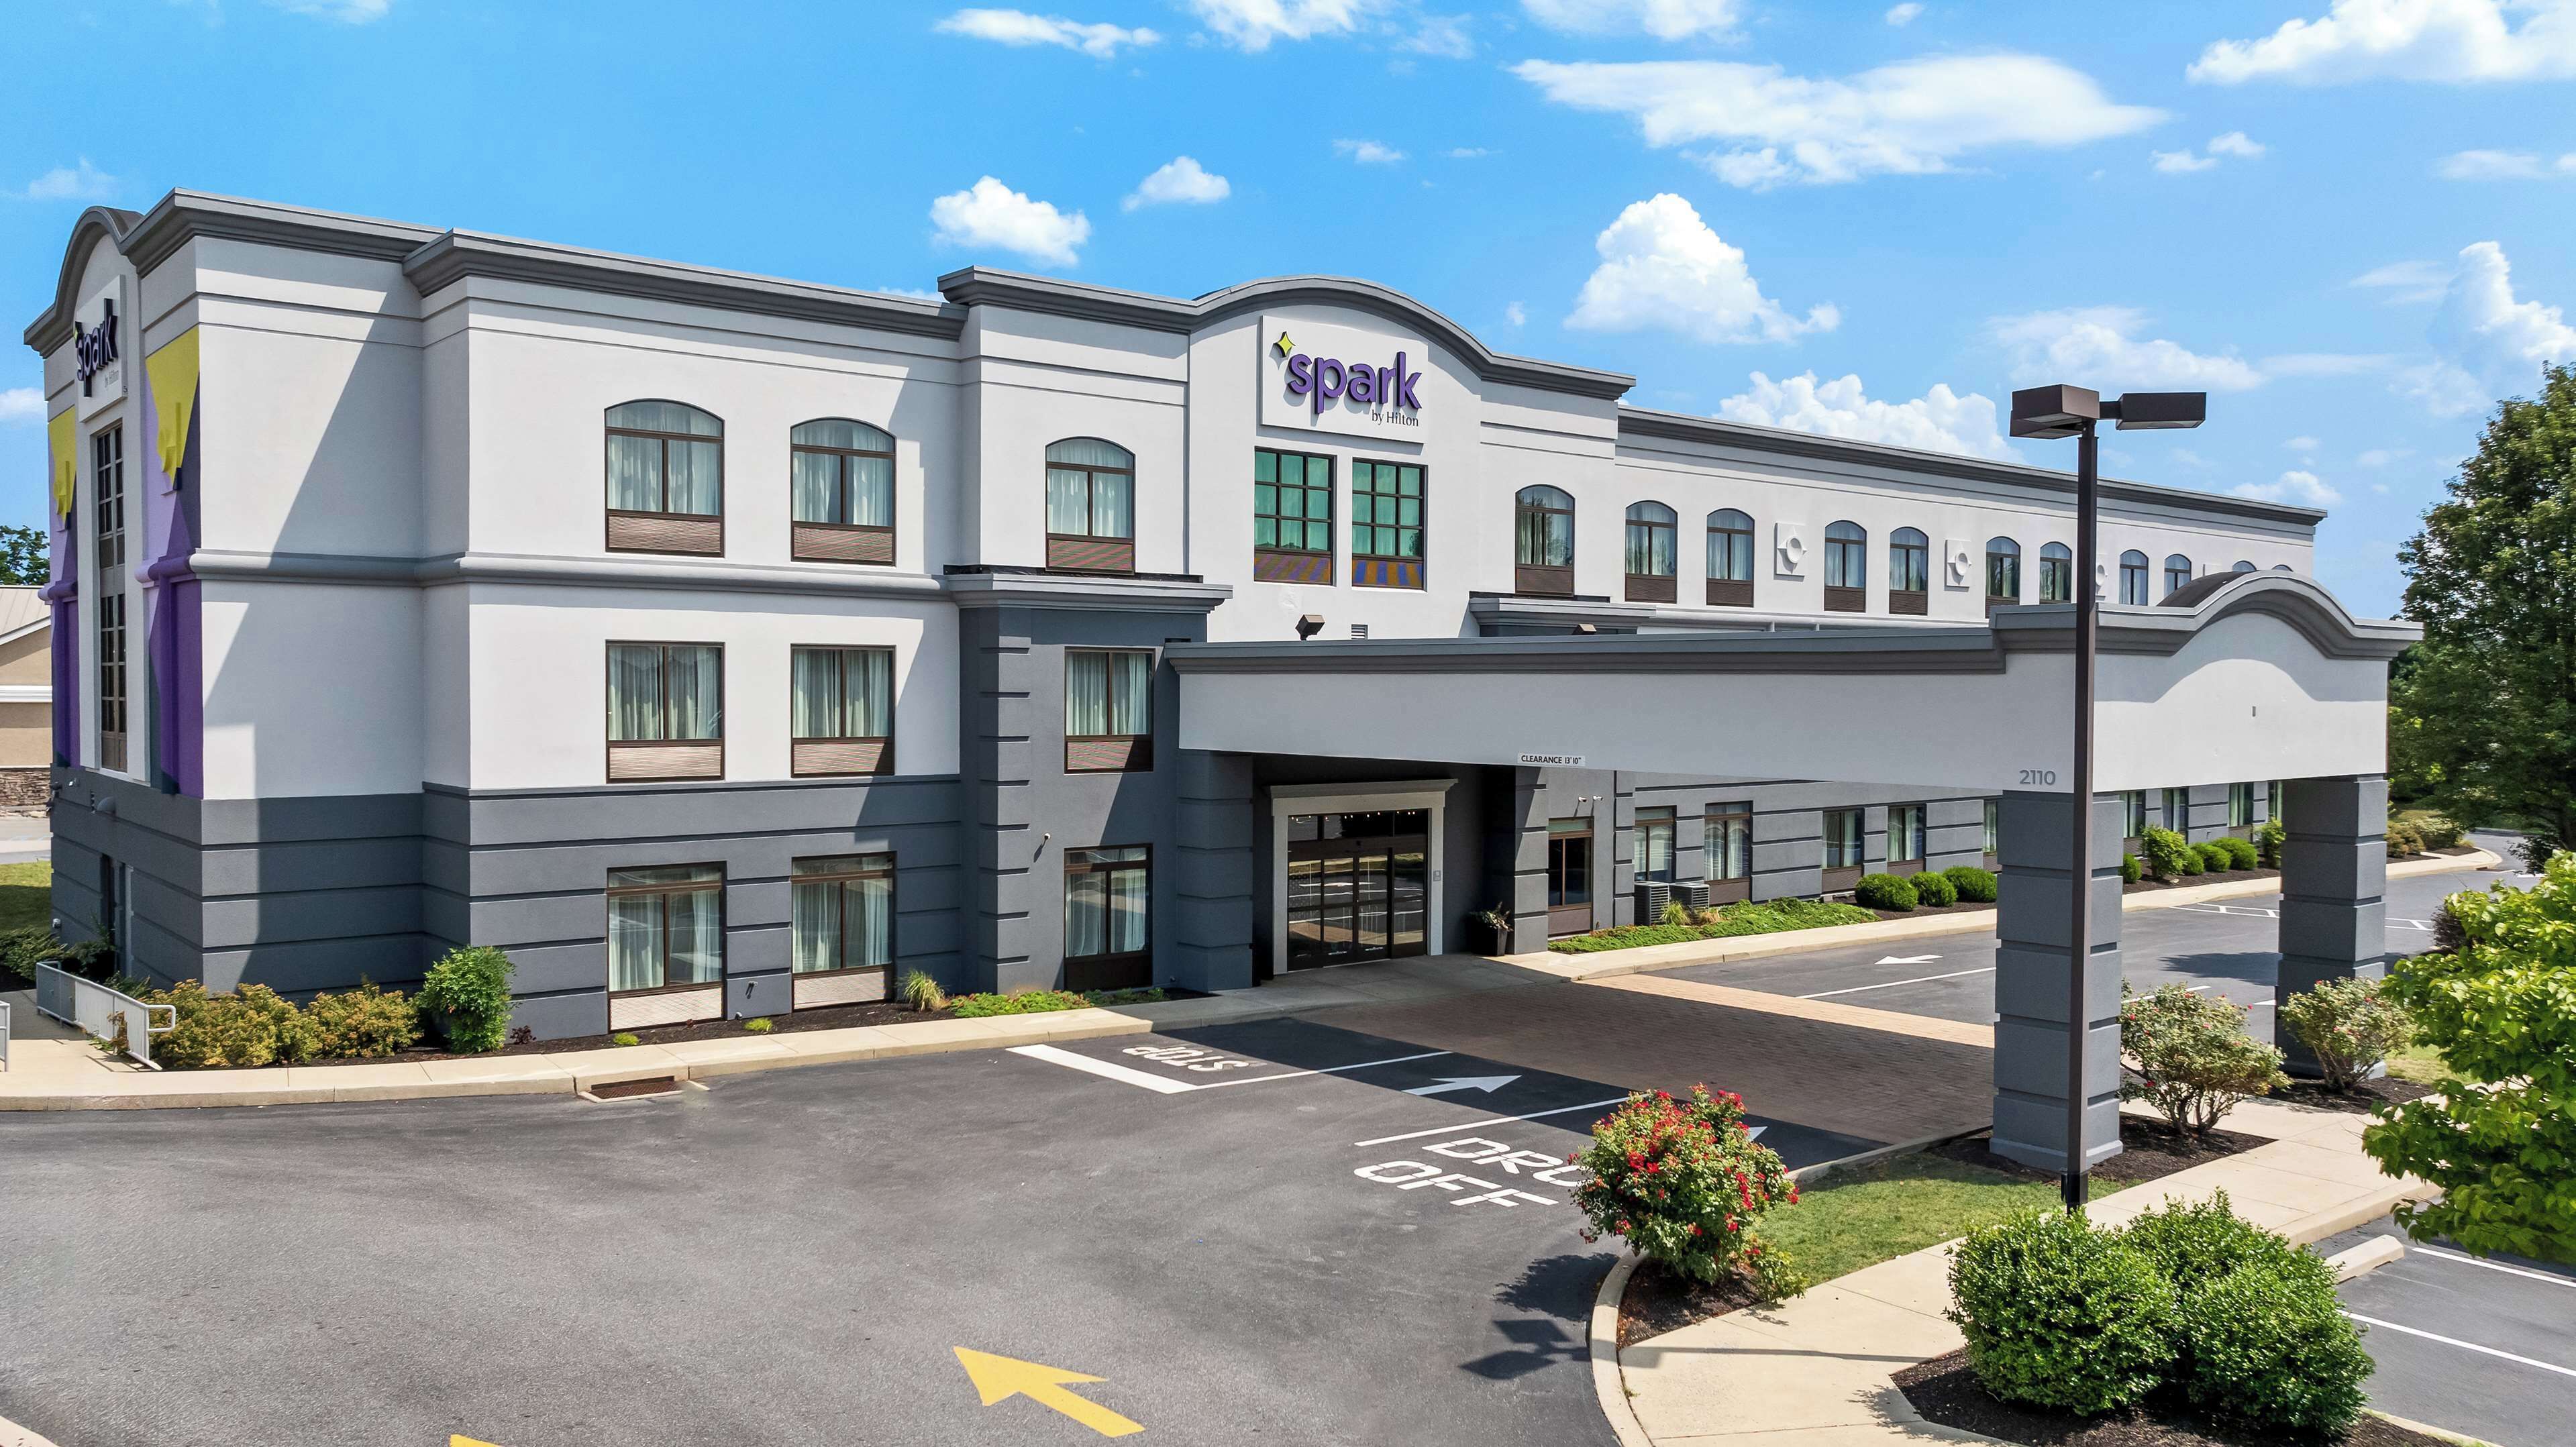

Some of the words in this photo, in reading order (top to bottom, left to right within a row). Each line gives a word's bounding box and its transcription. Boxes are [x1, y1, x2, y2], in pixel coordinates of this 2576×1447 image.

[1287, 352, 1423, 415] spark
[1372, 409, 1384, 425] by
[1386, 411, 1419, 427] Hilton
[1521, 755, 1562, 764] CLEARANCE
[2019, 769, 2056, 786] 2110
[1122, 1046, 1253, 1071] STOP
[1421, 1137, 1593, 1187] DRO
[1353, 1161, 1559, 1207] OFF
